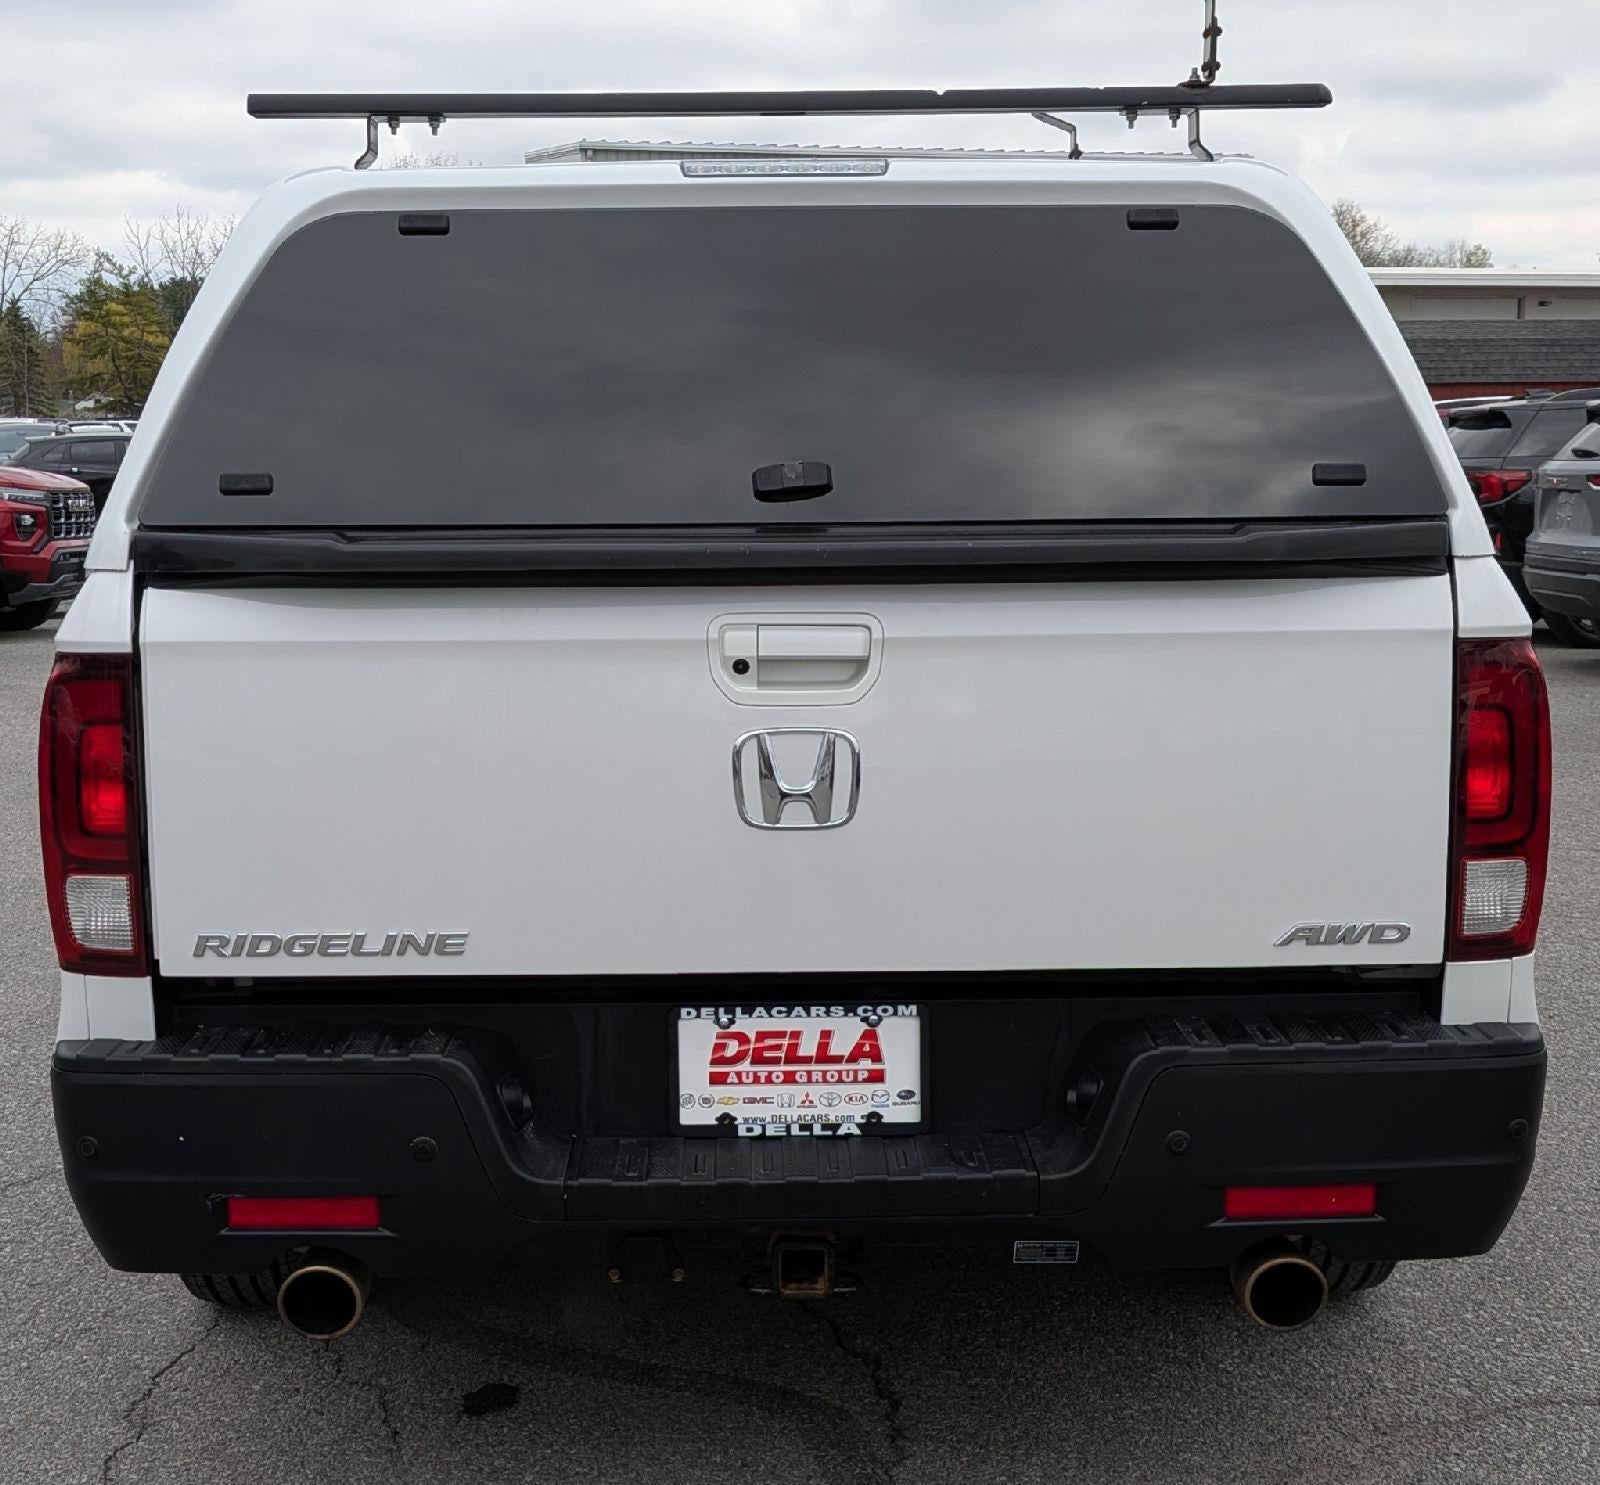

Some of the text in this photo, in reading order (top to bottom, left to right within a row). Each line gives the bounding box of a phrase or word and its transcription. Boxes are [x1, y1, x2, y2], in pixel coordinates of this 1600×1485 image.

[1272, 921, 1411, 946] AWD
[192, 930, 469, 957] RIDGELINE
[680, 1004, 918, 1019] DELLACARS.COM
[708, 1028, 885, 1067] DELLA
[726, 1070, 869, 1084] AUTO GROUP
[742, 1096, 775, 1105] GMC
[737, 1122, 862, 1137] DELLA
